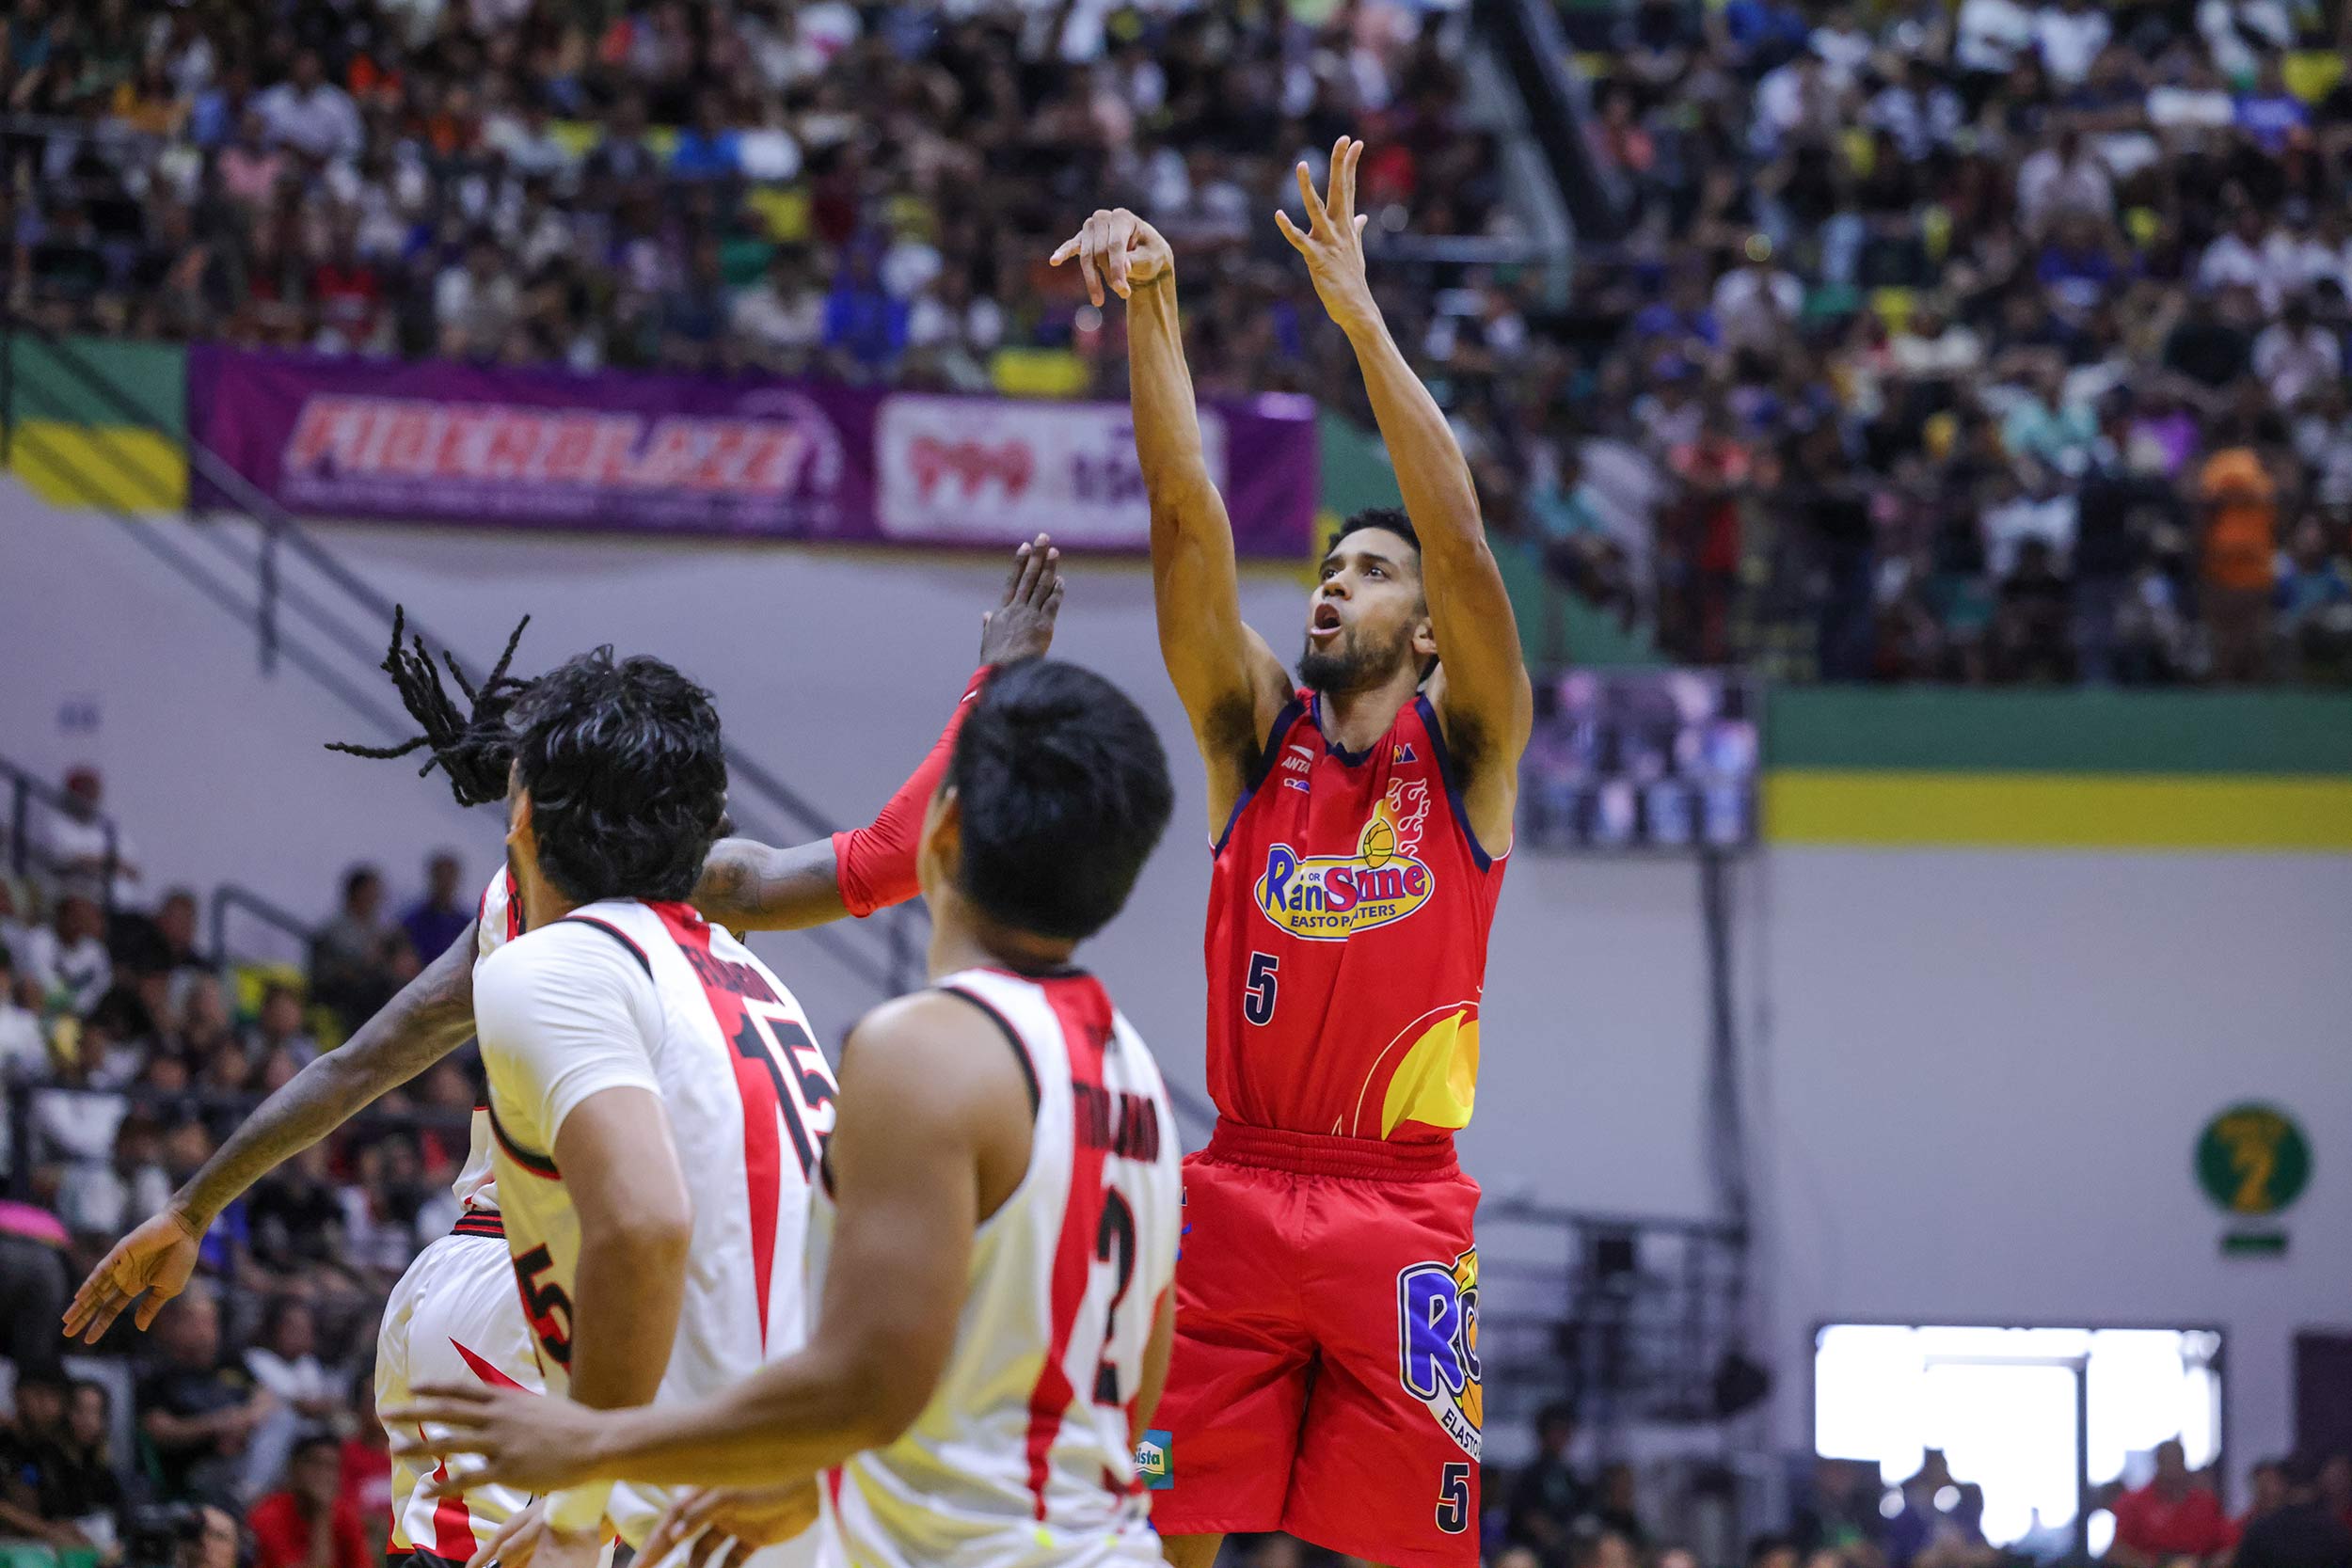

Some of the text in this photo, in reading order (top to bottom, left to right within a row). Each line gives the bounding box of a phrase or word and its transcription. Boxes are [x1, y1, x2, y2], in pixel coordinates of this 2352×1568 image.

[1244, 951, 1279, 1026] 5
[733, 1012, 837, 1198] 15
[1134, 1447, 1161, 1465] ista
[1435, 1462, 1470, 1534] 5
